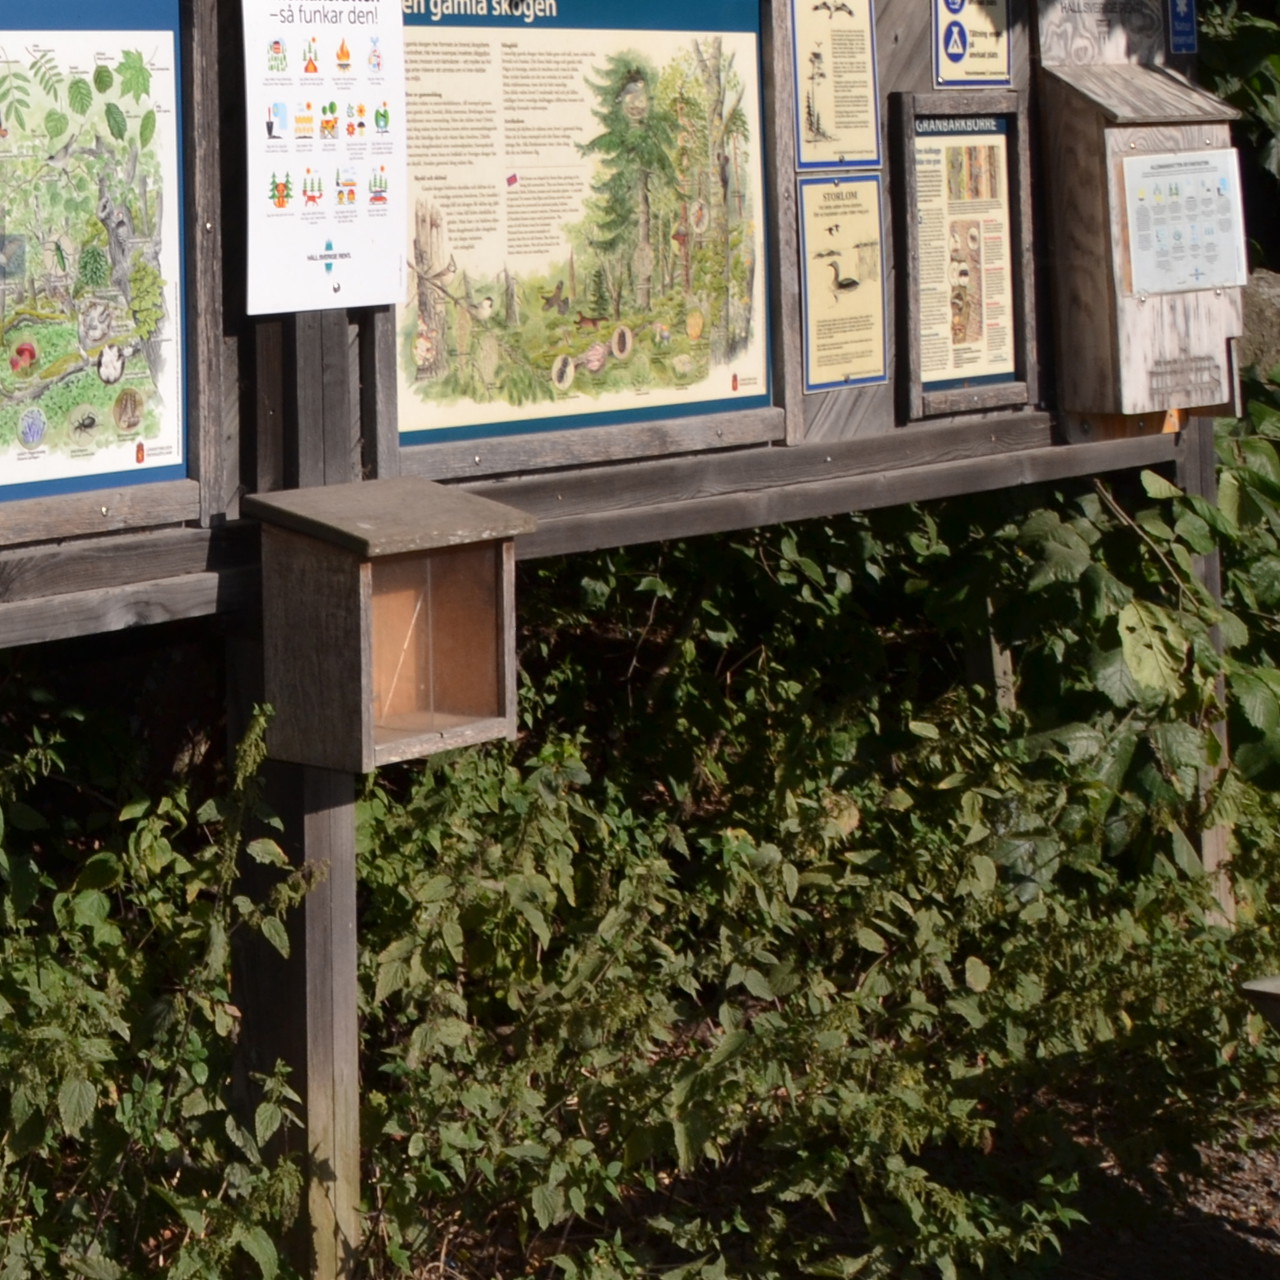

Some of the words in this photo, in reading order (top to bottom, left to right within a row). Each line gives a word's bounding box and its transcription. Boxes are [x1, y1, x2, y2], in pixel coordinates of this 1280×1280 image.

[298, 5, 345, 25] funkar
[347, 6, 379, 25] den!
[915, 117, 998, 133] GRANBARKBORRE
[822, 191, 858, 202] STORLOM
